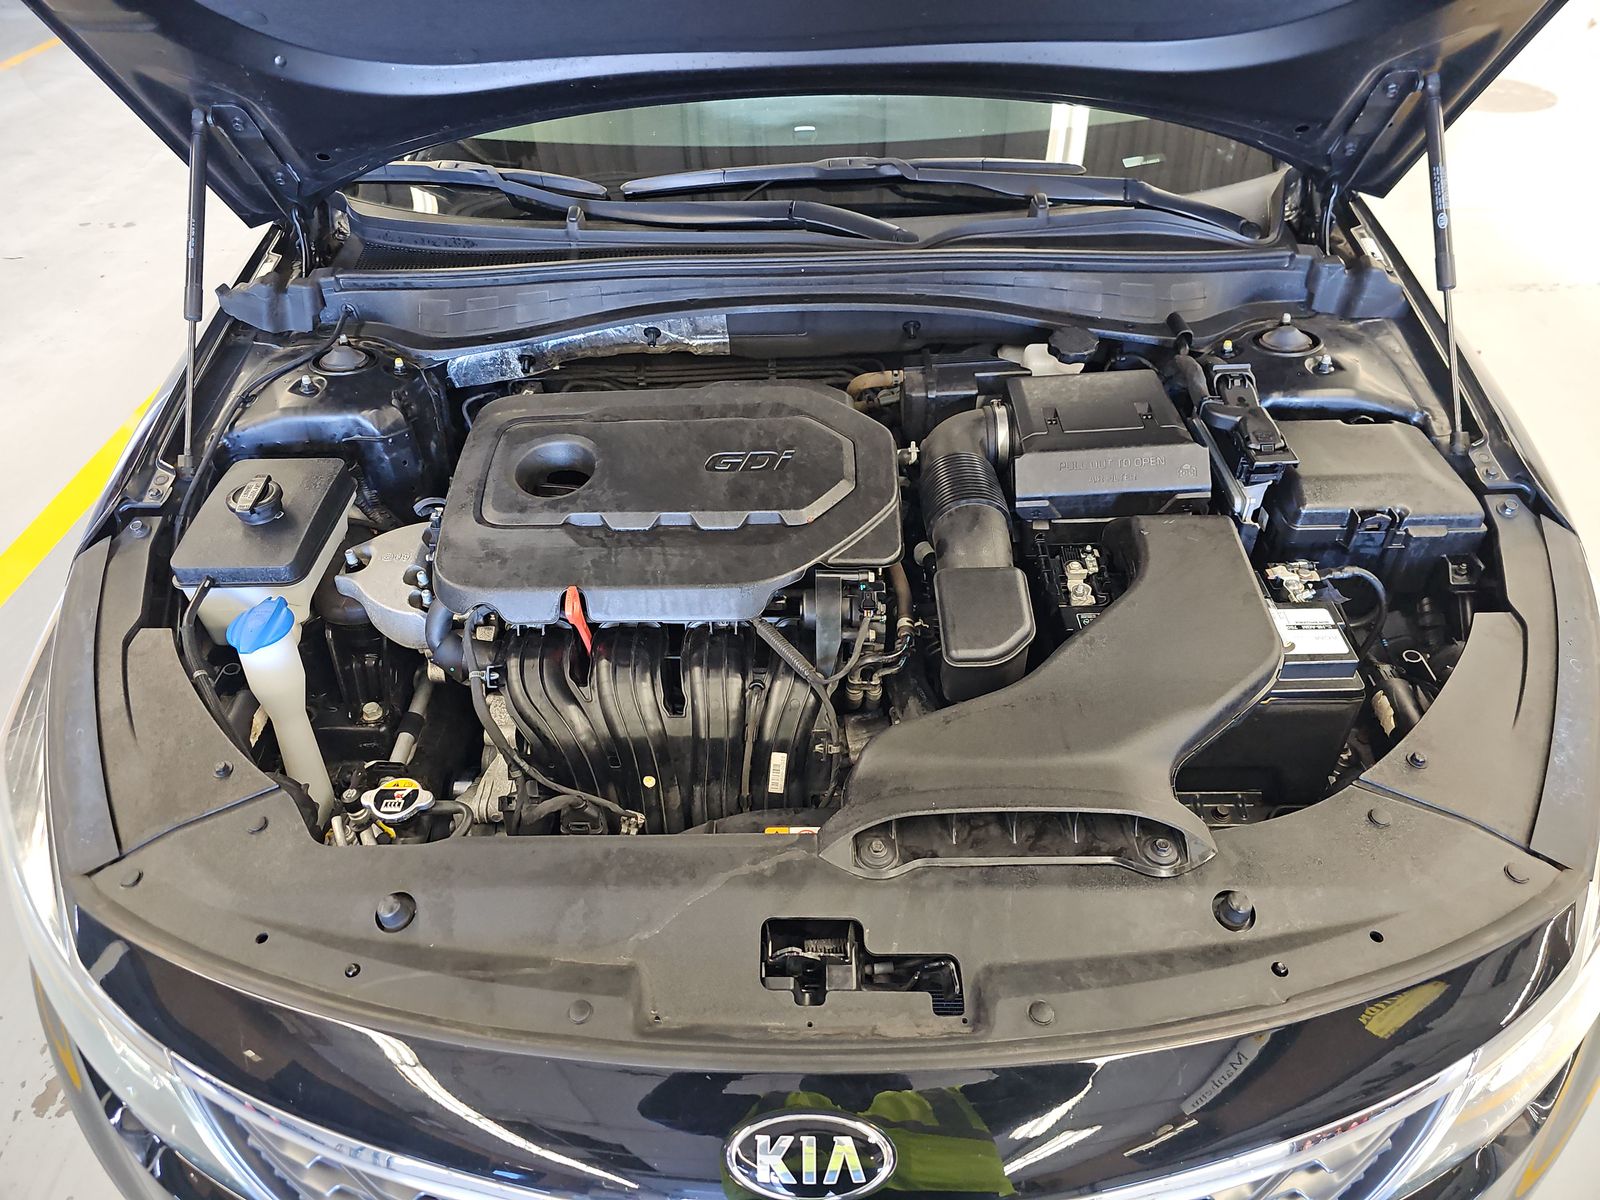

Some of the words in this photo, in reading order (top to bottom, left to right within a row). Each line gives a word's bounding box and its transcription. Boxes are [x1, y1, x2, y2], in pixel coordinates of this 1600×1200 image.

[703, 448, 796, 473] GDi
[1057, 460, 1086, 472] PULL
[1088, 458, 1114, 470] OUT
[1117, 457, 1132, 469] TO
[1134, 455, 1167, 467] OPEN
[754, 1134, 867, 1185] KIA
